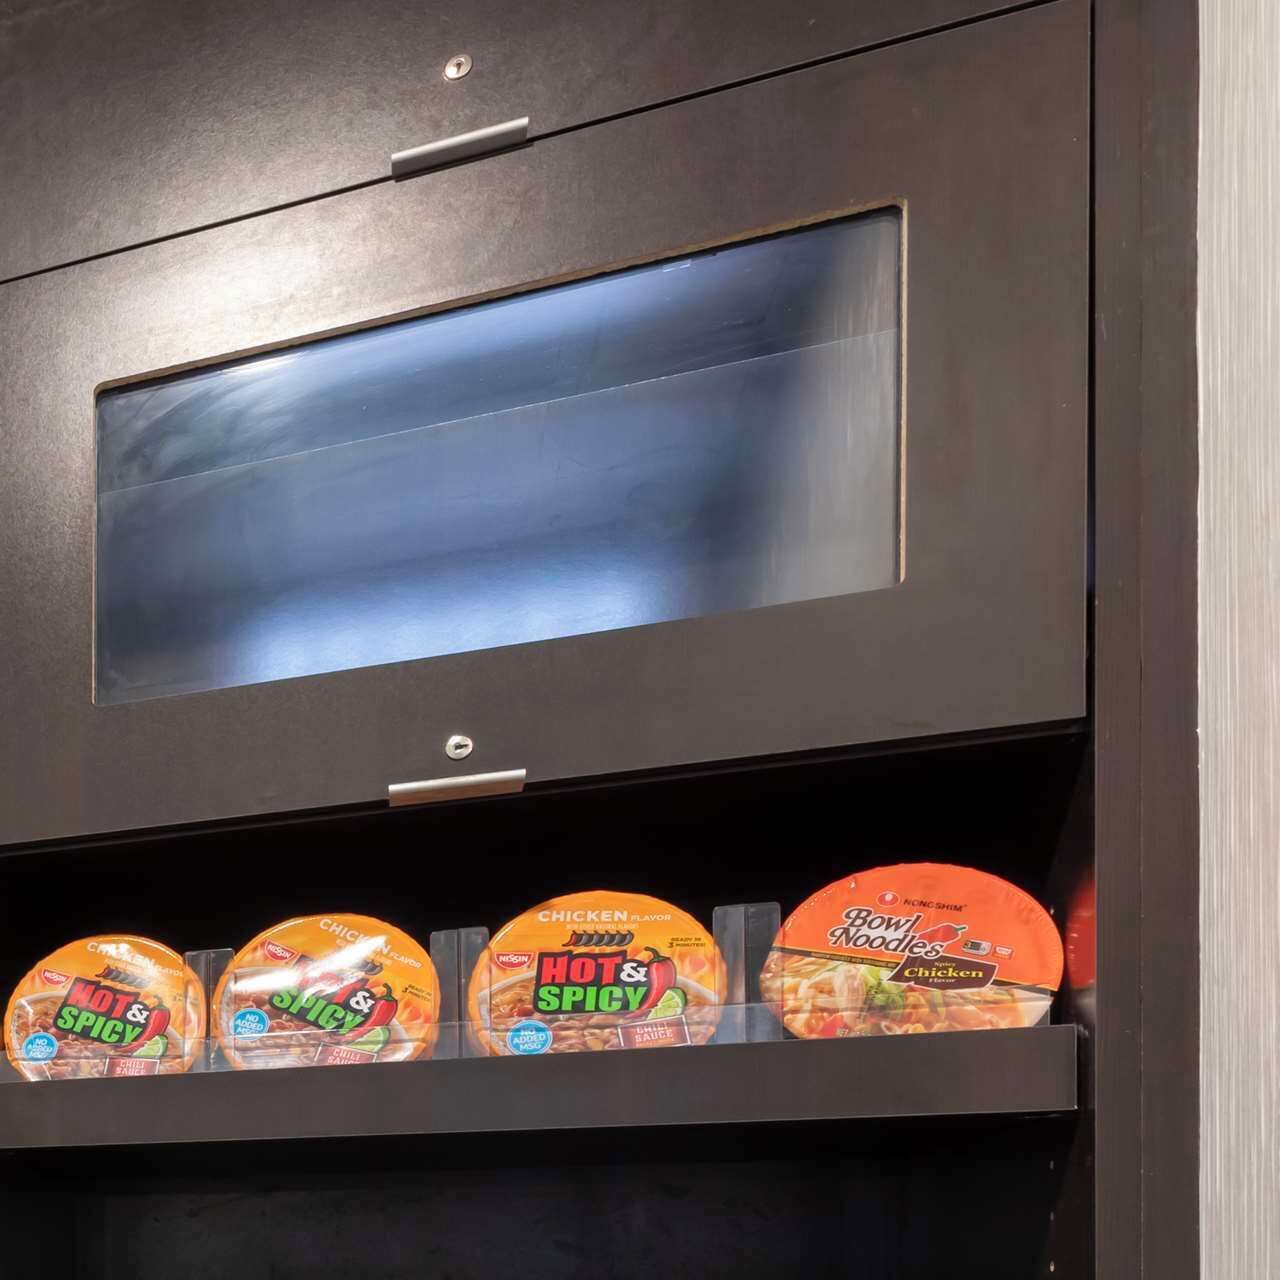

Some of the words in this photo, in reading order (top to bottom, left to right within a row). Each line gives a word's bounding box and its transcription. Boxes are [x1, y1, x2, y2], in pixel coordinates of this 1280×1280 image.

[538, 910, 628, 922] CHICKEN
[843, 907, 922, 934] Bowl
[829, 927, 944, 959] Noodles
[540, 955, 624, 985] HOT
[619, 962, 648, 983] &
[904, 967, 984, 978] Chicken
[66, 981, 135, 1018] HOT
[126, 1003, 149, 1024] &
[349, 991, 375, 1013] &
[537, 985, 648, 1012] SPICY
[56, 1006, 144, 1043] SPICY
[635, 1030, 673, 1042] SAUCE
